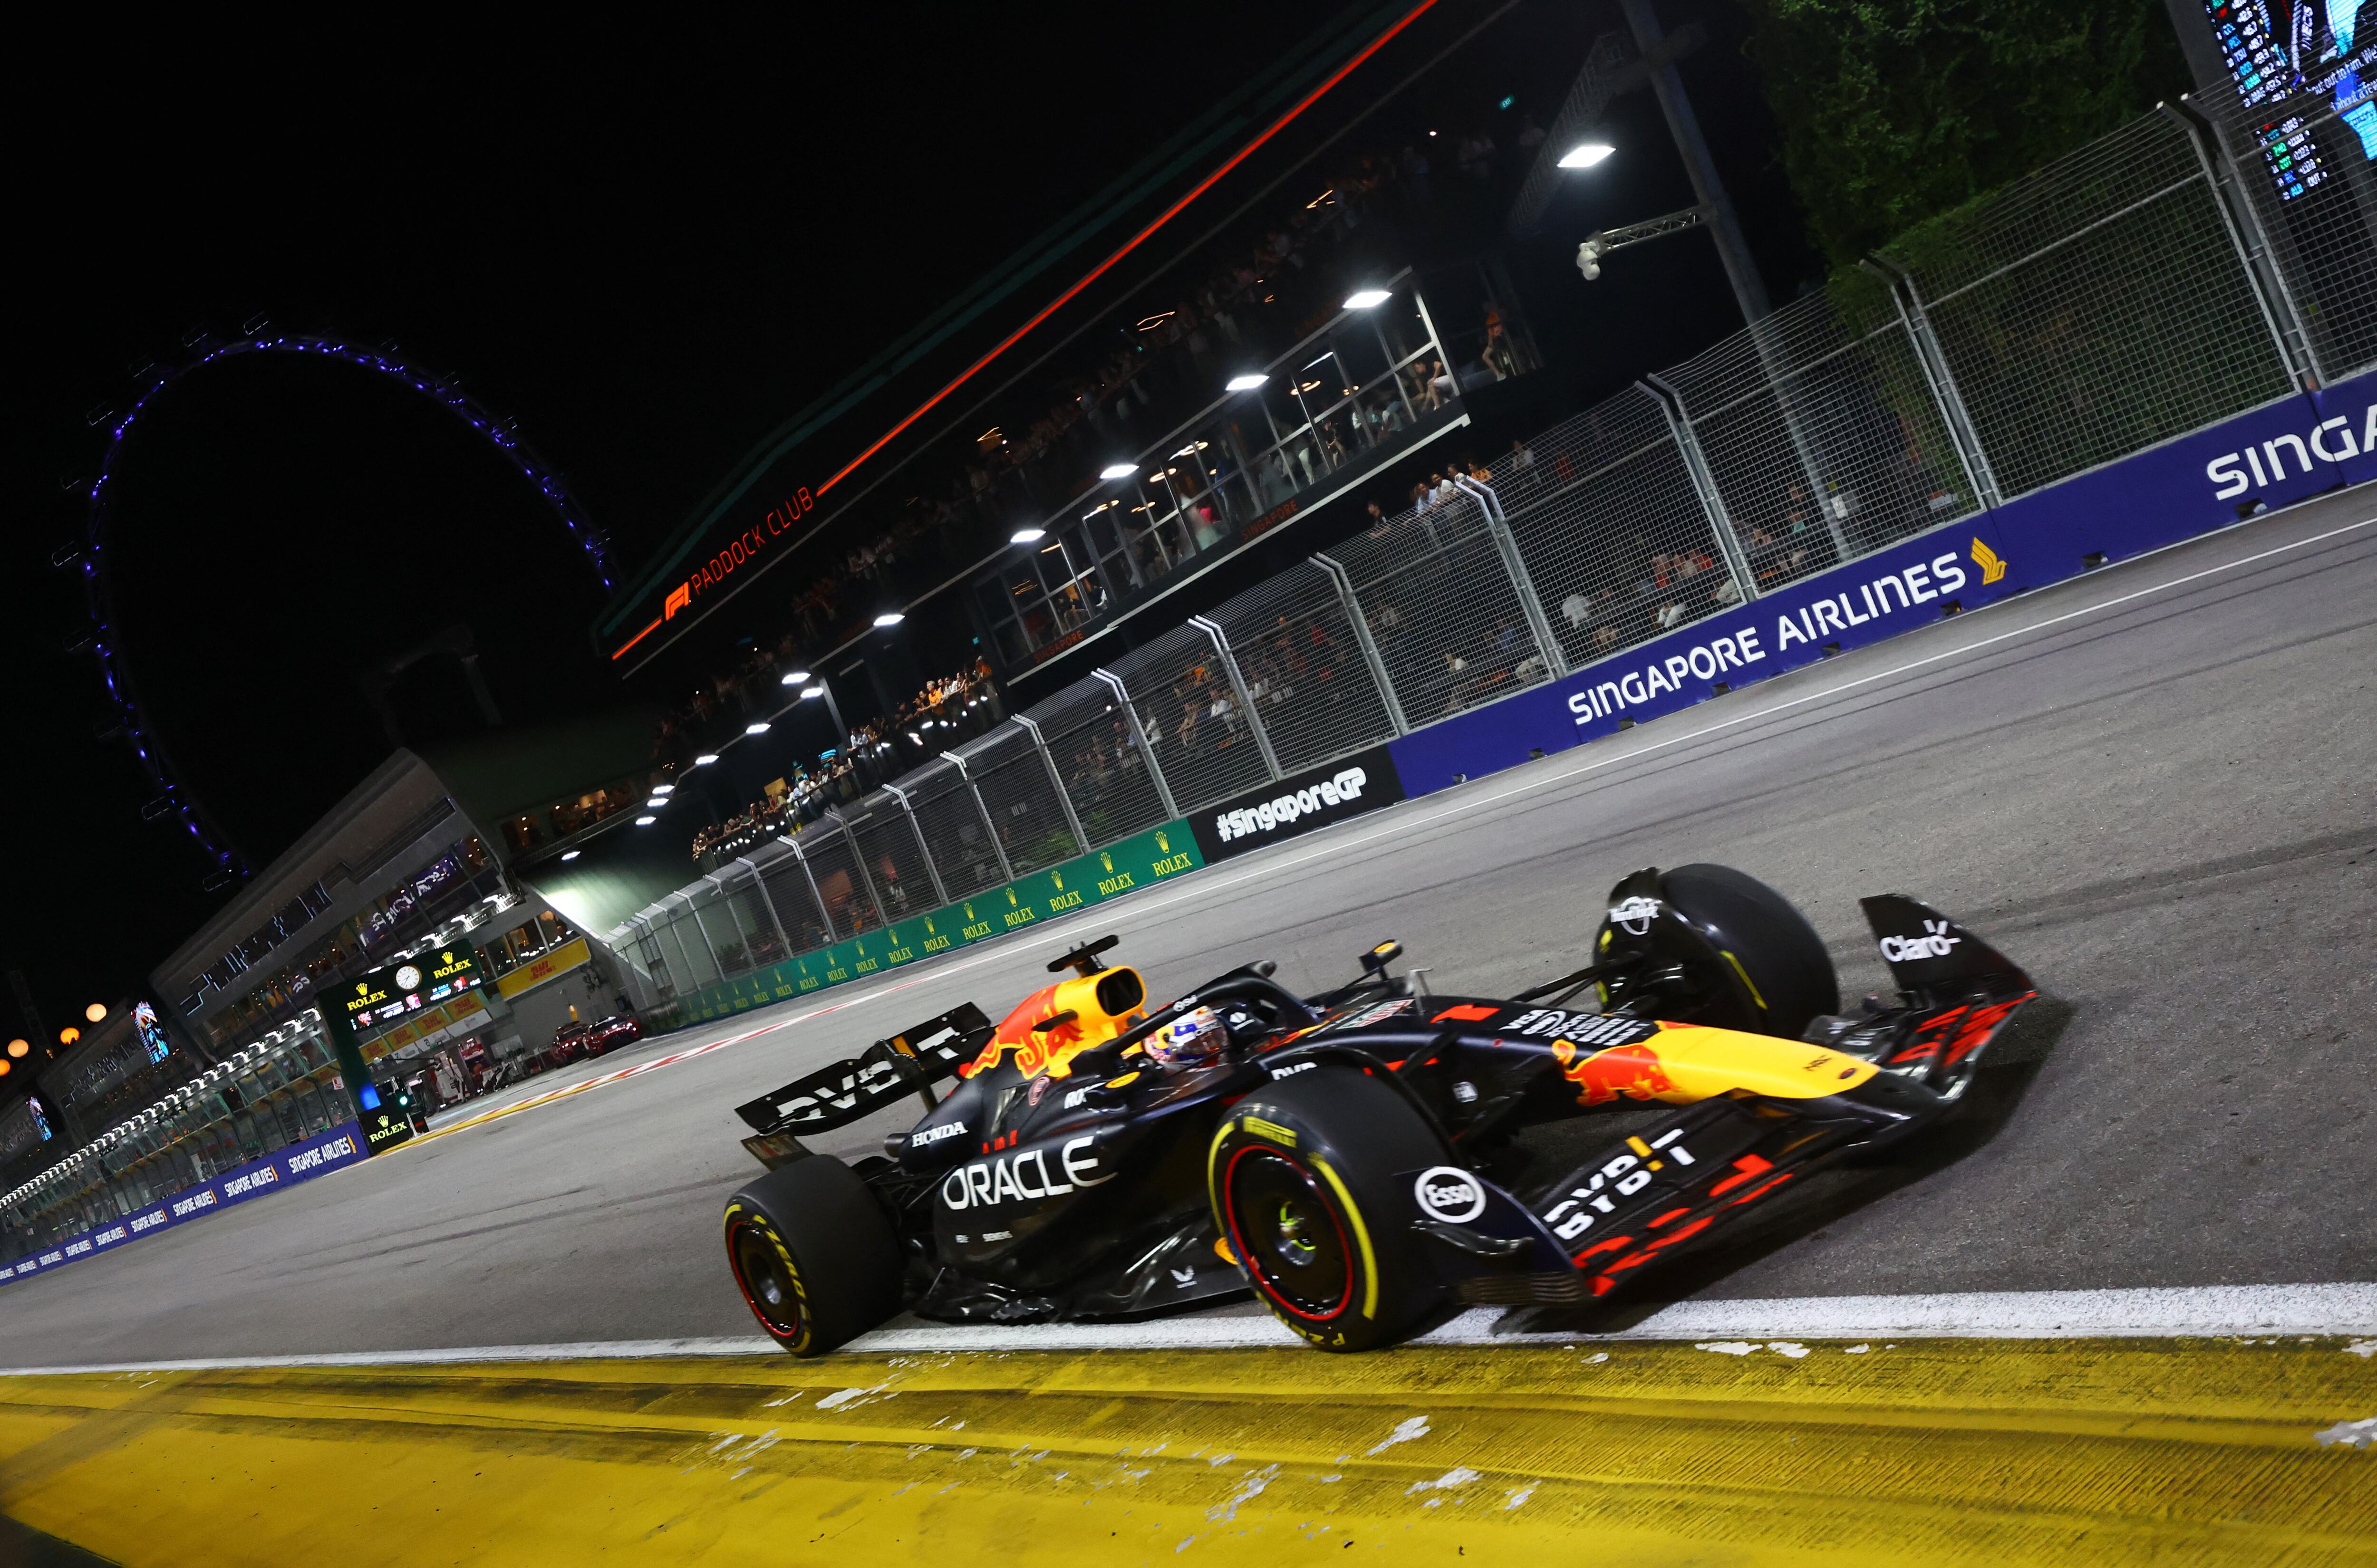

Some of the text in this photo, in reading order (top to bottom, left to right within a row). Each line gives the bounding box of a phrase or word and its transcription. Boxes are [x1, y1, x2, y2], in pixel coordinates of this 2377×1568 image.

[2233, 48, 2247, 62] TSU
[1241, 500, 1299, 541] SINGAPORE
[692, 525, 766, 595] PADDOCK
[767, 487, 813, 536] CLUB
[1034, 629, 1084, 664] SINGAPORE
[1568, 551, 1966, 725] SINGAPORE AIRLINES
[1216, 767, 1367, 843] #SingaporeGP
[1152, 853, 1192, 877] ROLEX
[1098, 873, 1135, 896] ROLEX
[1050, 890, 1082, 912] ROLEX
[1004, 907, 1035, 926] ROLEX
[963, 921, 992, 940] ROLEX
[924, 935, 951, 952] ROLEX
[1880, 933, 1952, 962] Claro
[856, 958, 879, 973] ROLEX
[889, 947, 913, 964] ROLEX
[433, 959, 472, 979] ROLEX
[827, 968, 848, 982] ROLEX
[799, 977, 819, 991] ROLEX
[347, 991, 387, 1011] ROLEX
[369, 1121, 407, 1143] ROLEX
[911, 1121, 969, 1147] HONDA
[289, 1136, 351, 1174] SINGAPORE AIRLINES
[224, 1166, 275, 1198] SINGAPORE AIRLINES
[943, 1135, 1119, 1210] ORACLE
[173, 1190, 214, 1217] SINGAPORE AIRLINES
[1426, 1182, 1475, 1207] Esso
